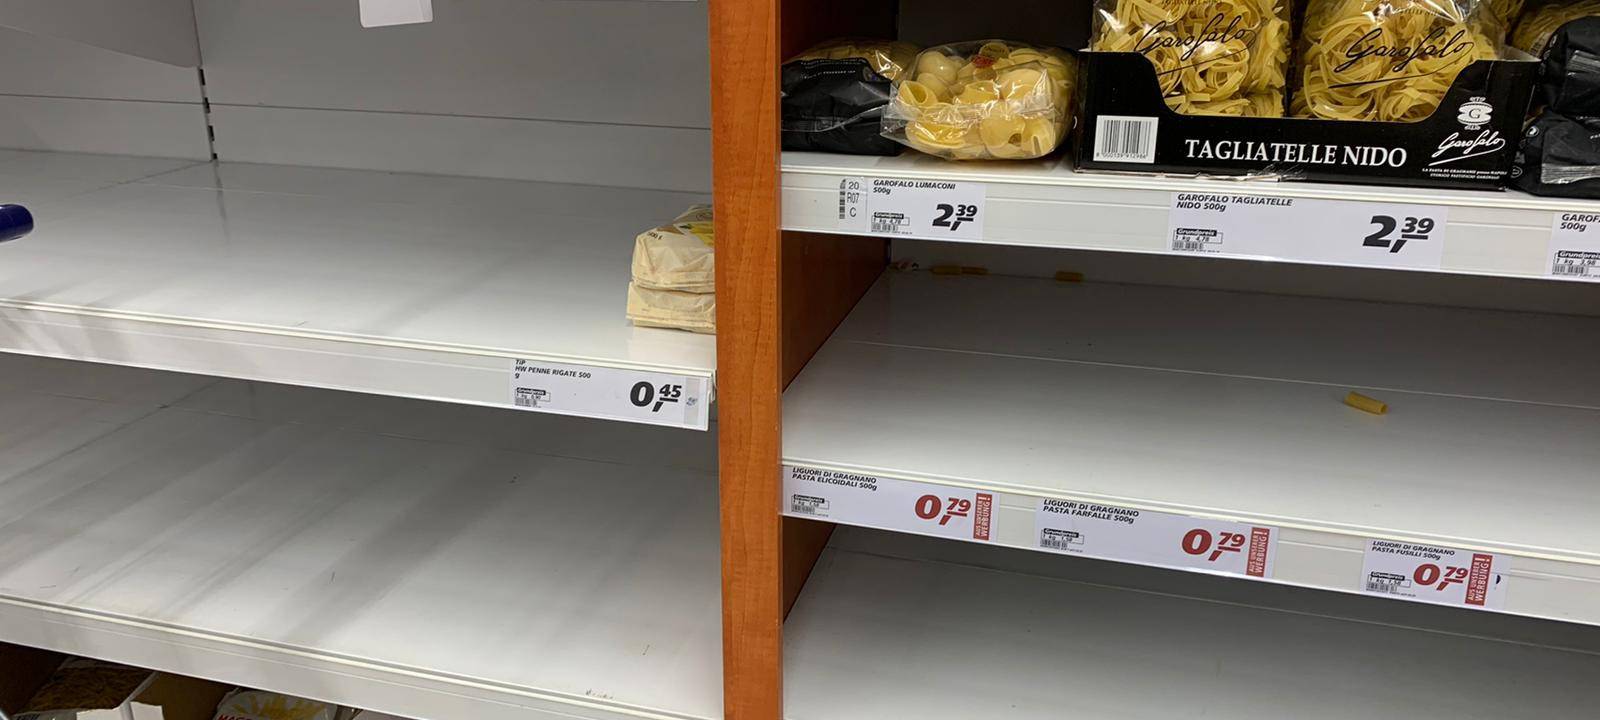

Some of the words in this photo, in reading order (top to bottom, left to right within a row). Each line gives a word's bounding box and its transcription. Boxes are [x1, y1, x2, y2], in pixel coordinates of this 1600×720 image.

[1134, 13, 1256, 62] Garofalo
[1333, 26, 1474, 76] Garofalo
[1185, 138, 1337, 166] TAGLIATELLE
[1341, 142, 1407, 168] NIDO
[1429, 129, 1506, 161] Garofalo
[848, 182, 860, 190] 20
[873, 180, 914, 188] GAROFALO
[916, 182, 956, 190] LUMACONI
[873, 187, 891, 195] 500g
[1176, 202, 1201, 210] NIDO
[1204, 202, 1227, 212] 500g
[1177, 194, 1229, 204] GAROFALO
[1231, 196, 1294, 206] TAGLIATELLE
[850, 207, 857, 217] C
[1562, 213, 1600, 223] GAROF
[1177, 228, 1217, 236] Grundpreis
[1560, 222, 1587, 232] 500g
[528, 366, 551, 374] PENNE
[552, 370, 577, 378] RIGATE
[792, 467, 822, 478] LIGUORI
[833, 472, 877, 484] GRAGNANO
[792, 473, 816, 482] PASTA
[817, 476, 858, 488] ELICOIDALI
[860, 482, 878, 491] 500g
[1042, 506, 1070, 516] PASTA
[1071, 508, 1112, 521] FARFALLE
[1114, 514, 1134, 524] 500g
[1044, 499, 1078, 510] LIGUORI
[1090, 504, 1140, 517] GRAGNANO
[979, 496, 991, 537] WERBUNG!
[1254, 530, 1268, 573] WERBUNG!
[1373, 540, 1402, 548] LIGUORI
[1413, 545, 1455, 556] GRAGNANO
[1423, 552, 1441, 560] 500g
[1470, 562, 1480, 588] UNSERER
[1475, 558, 1490, 601] WERBUNG!
